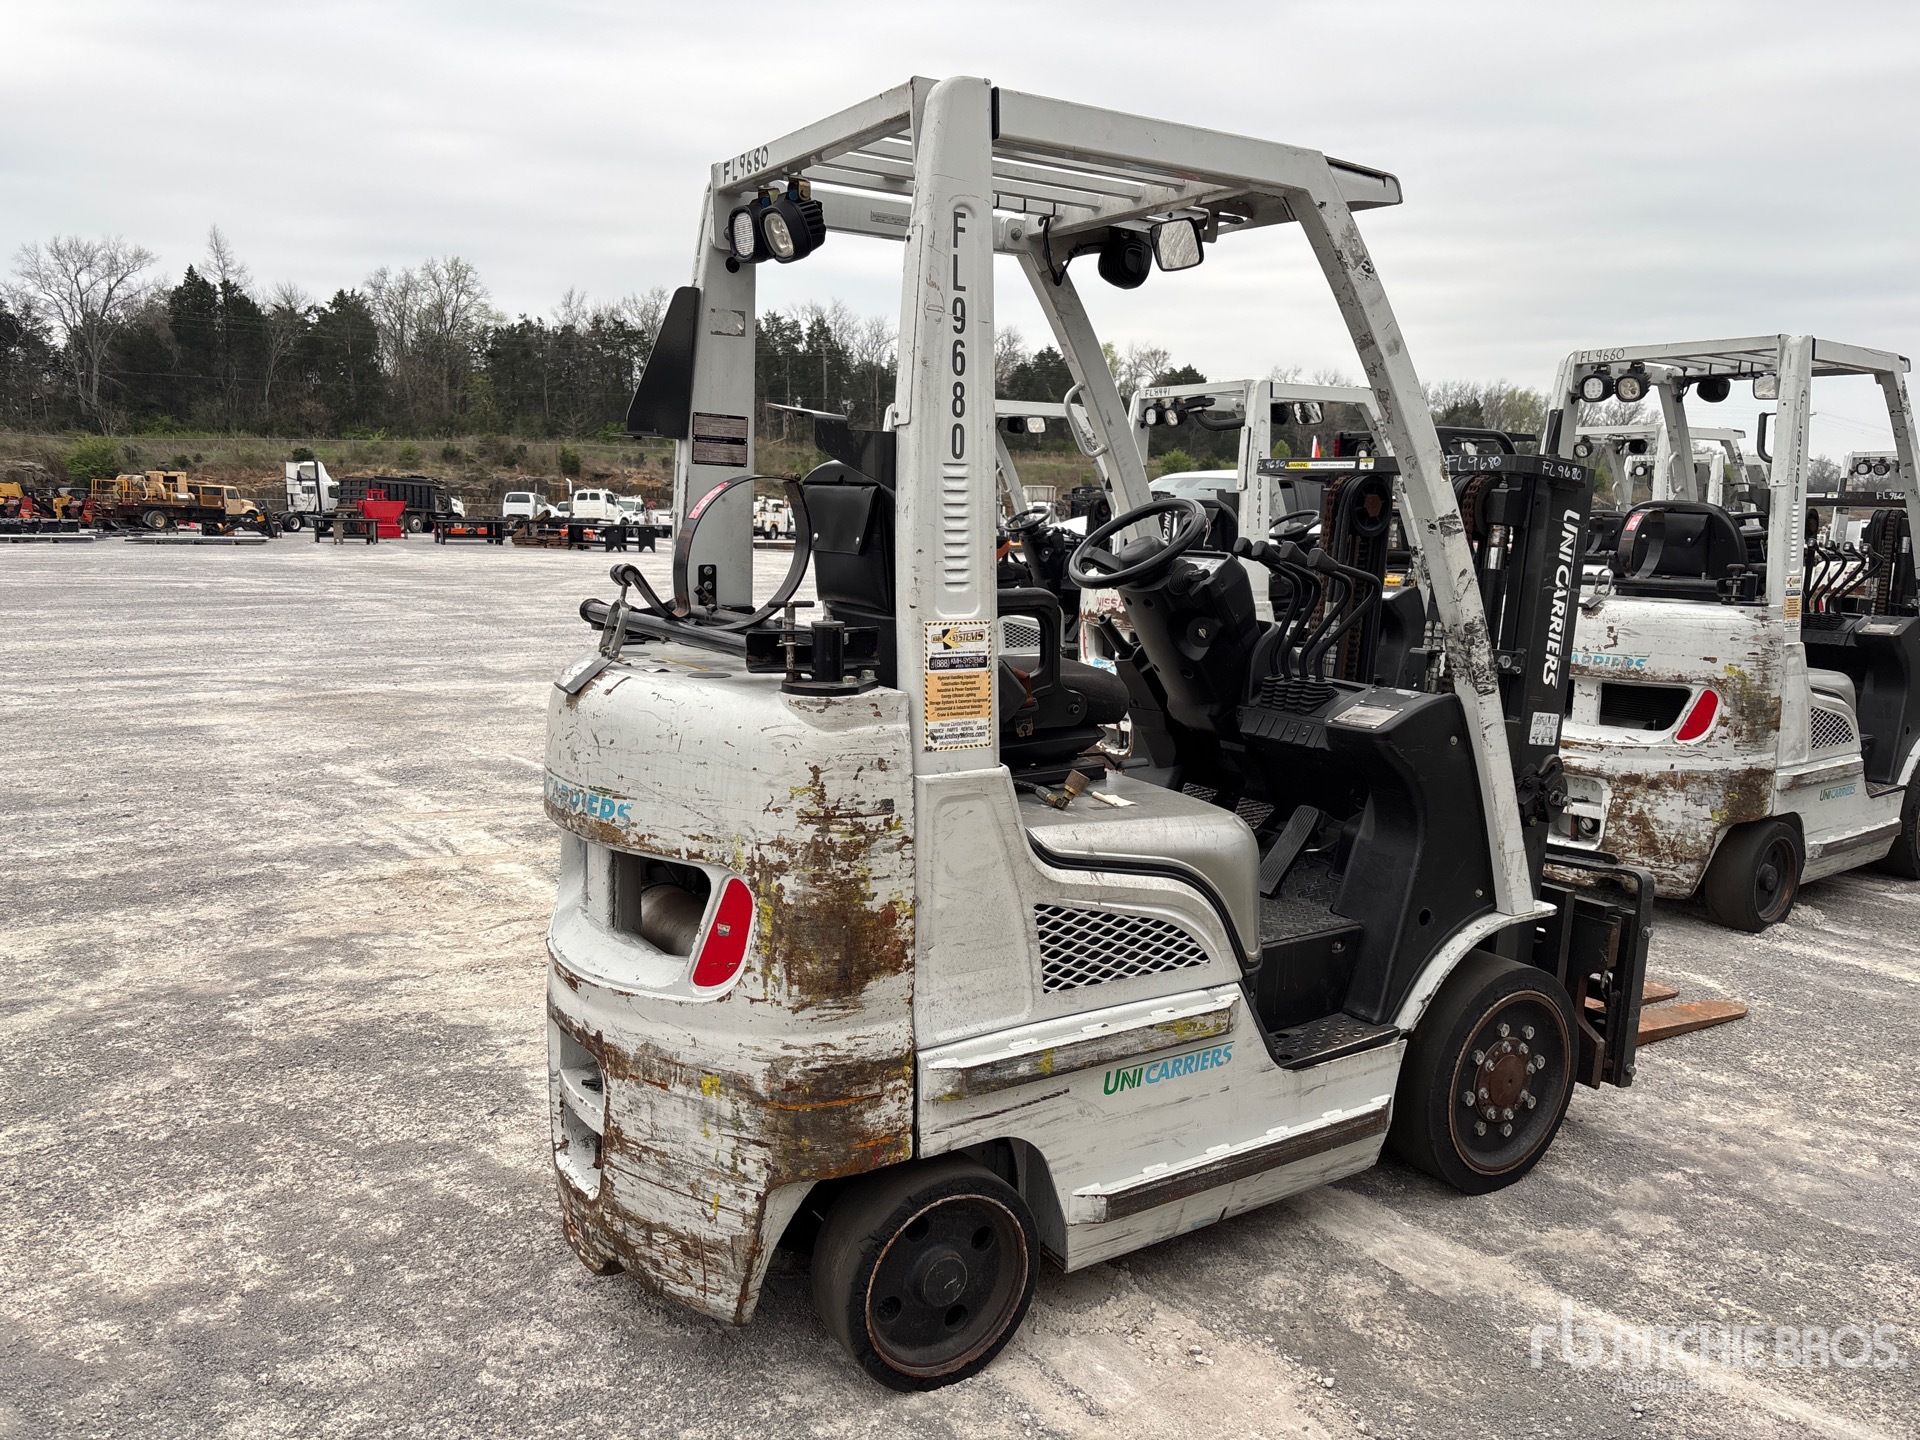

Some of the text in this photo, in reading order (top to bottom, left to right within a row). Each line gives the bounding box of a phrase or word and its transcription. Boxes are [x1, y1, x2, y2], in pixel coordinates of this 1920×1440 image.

[723, 145, 769, 185] FL9680
[951, 211, 967, 460] FL9680
[1580, 348, 1625, 363] FL9660
[1444, 454, 1502, 472] FL9680
[1541, 460, 1582, 481] FL9680
[1876, 491, 1906, 500] FL966
[1096, 597, 1125, 608] NISSA
